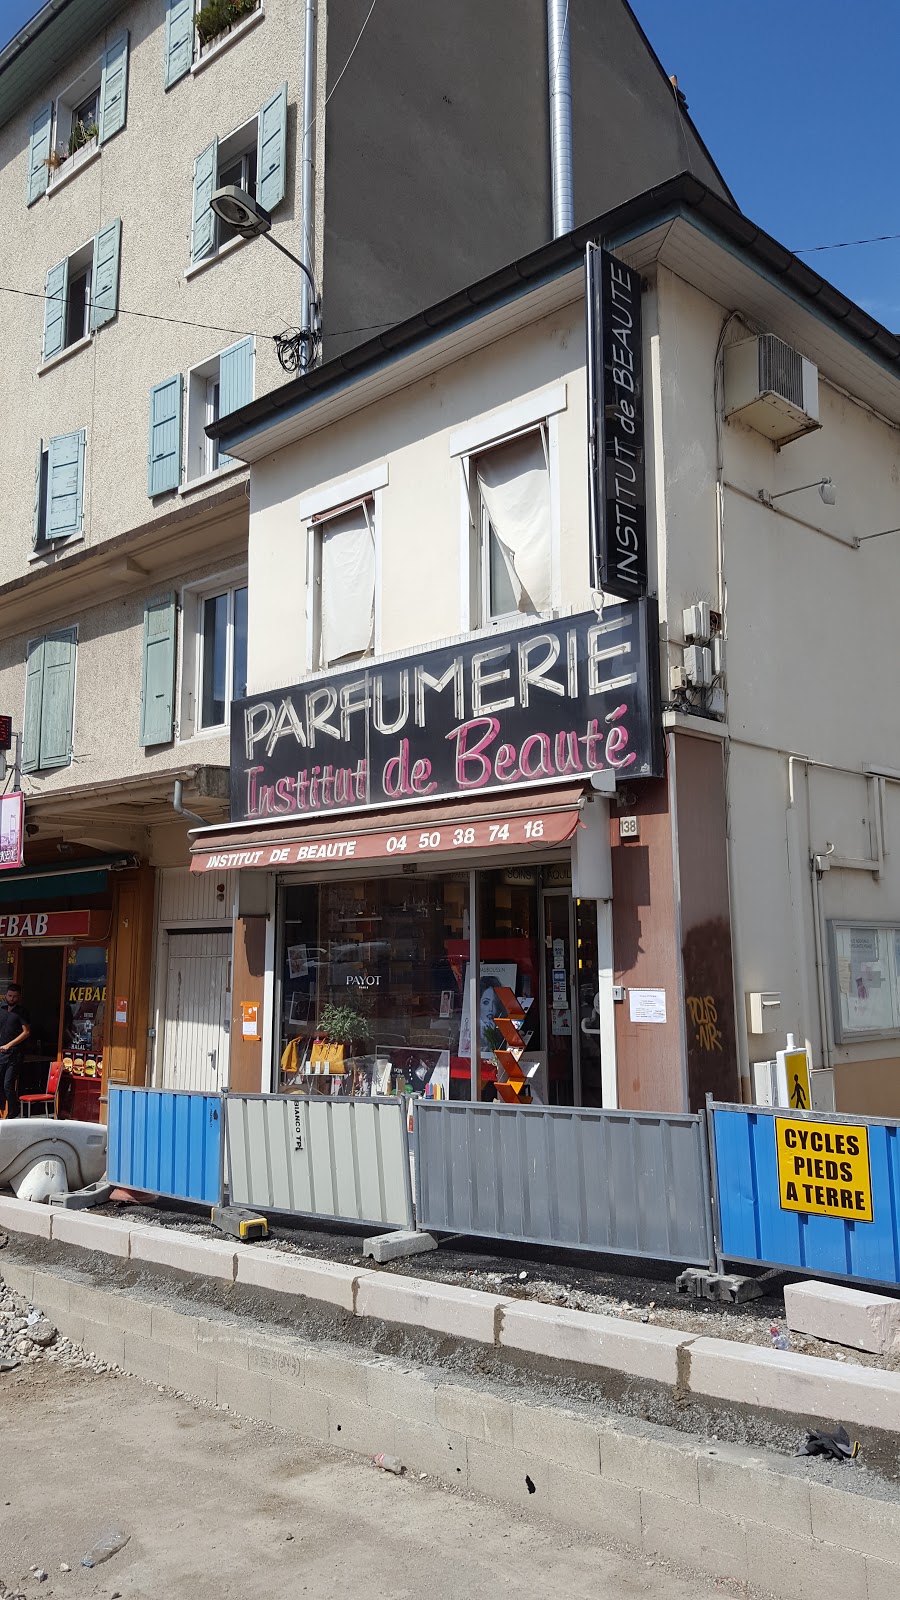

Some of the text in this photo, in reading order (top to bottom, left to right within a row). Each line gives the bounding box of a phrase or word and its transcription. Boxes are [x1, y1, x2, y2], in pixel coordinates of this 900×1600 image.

[610, 262, 638, 584] INSTITUT de BEAUTE
[244, 614, 638, 760] PARFUMERIE
[244, 703, 636, 819] Institut de Beauté
[620, 820, 636, 833] 138
[206, 820, 544, 868] INSTITUT DE BEAUTE 04 50 38 74 18
[0, 913, 48, 936] EBAB
[346, 975, 382, 986] PAYOT
[784, 1128, 860, 1156] CYCLES
[794, 1156, 853, 1182] PIEDS
[786, 1181, 866, 1211] A TERRE
